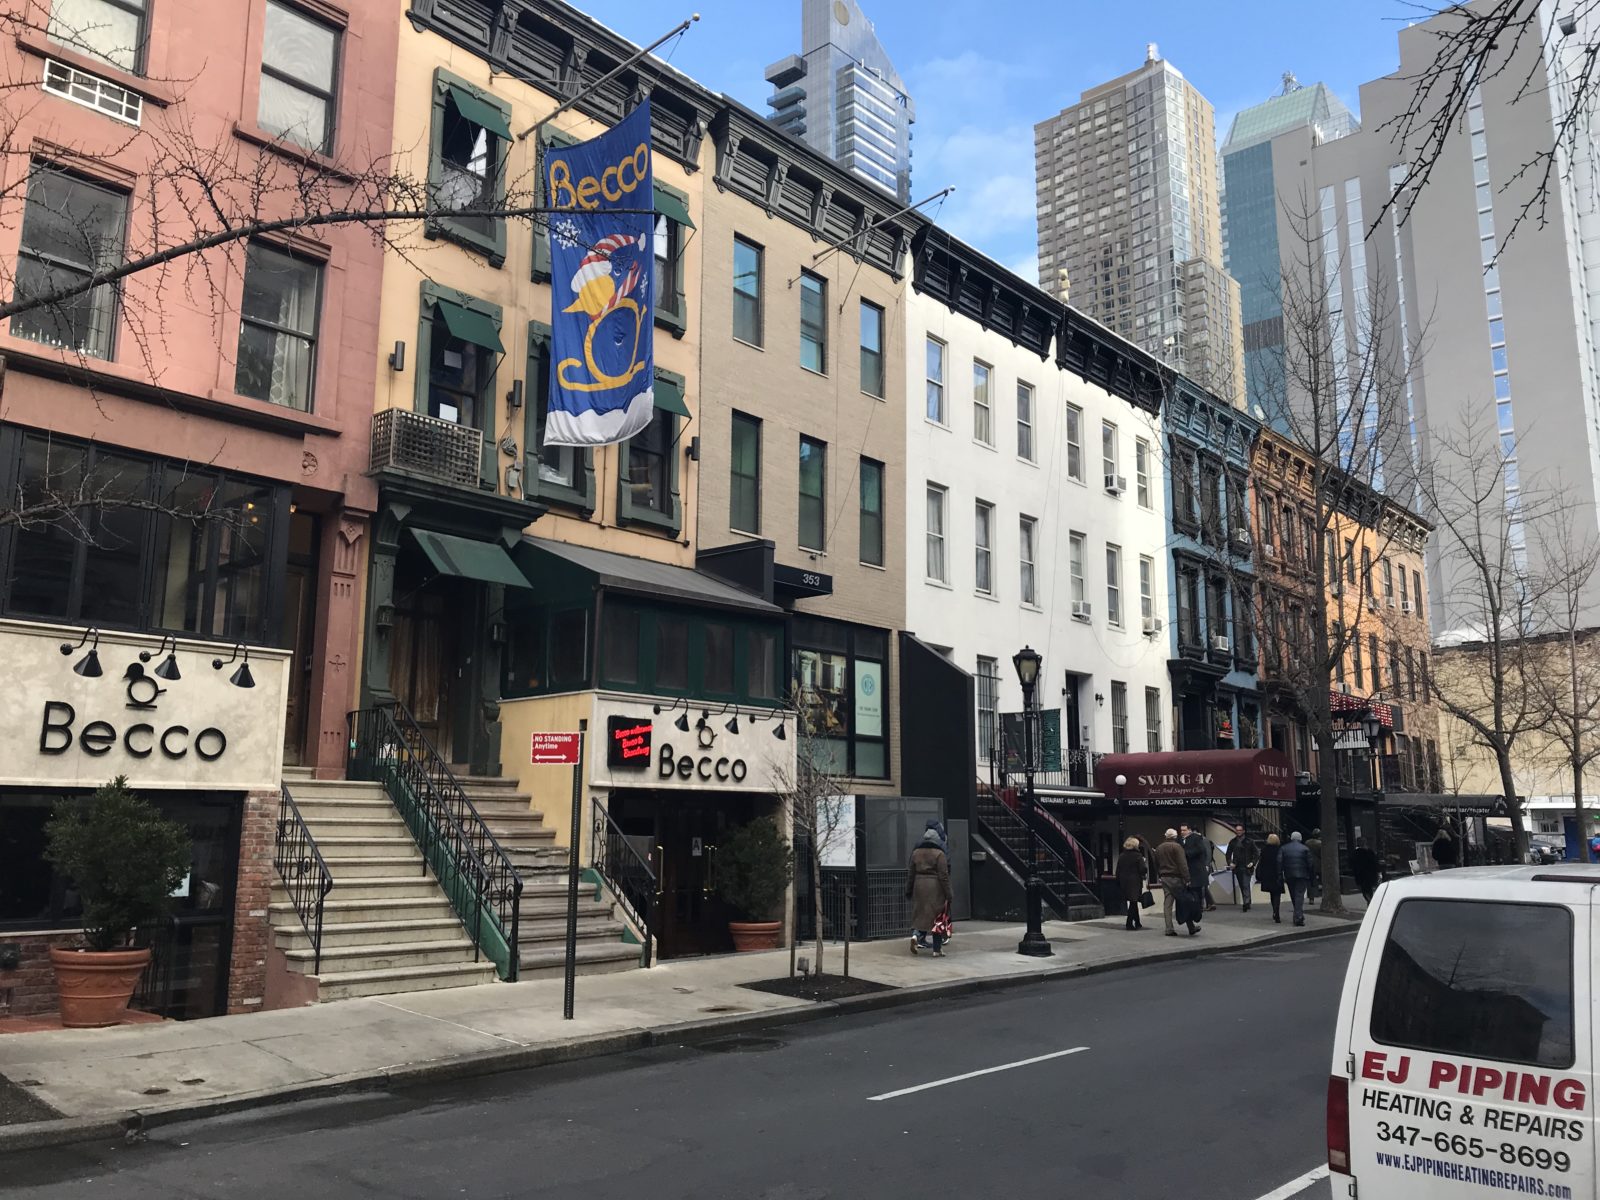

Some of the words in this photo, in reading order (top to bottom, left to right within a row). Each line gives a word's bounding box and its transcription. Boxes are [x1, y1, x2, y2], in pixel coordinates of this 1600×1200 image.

[549, 143, 648, 210] Becco
[803, 573, 820, 586] 353
[39, 700, 227, 761] Becco
[534, 735, 543, 743] NO
[544, 735, 572, 743] STANDING
[659, 743, 747, 782] Becco
[1138, 774, 1191, 785] SWING
[1195, 773, 1214, 785] 46
[1361, 1050, 1411, 1084] EJ
[1428, 1060, 1587, 1111] PIPING
[1362, 1088, 1452, 1122] HEATING
[1459, 1105, 1475, 1126] &
[1484, 1108, 1585, 1142] REPAIRS
[1376, 1121, 1571, 1173] 347-665-8699
